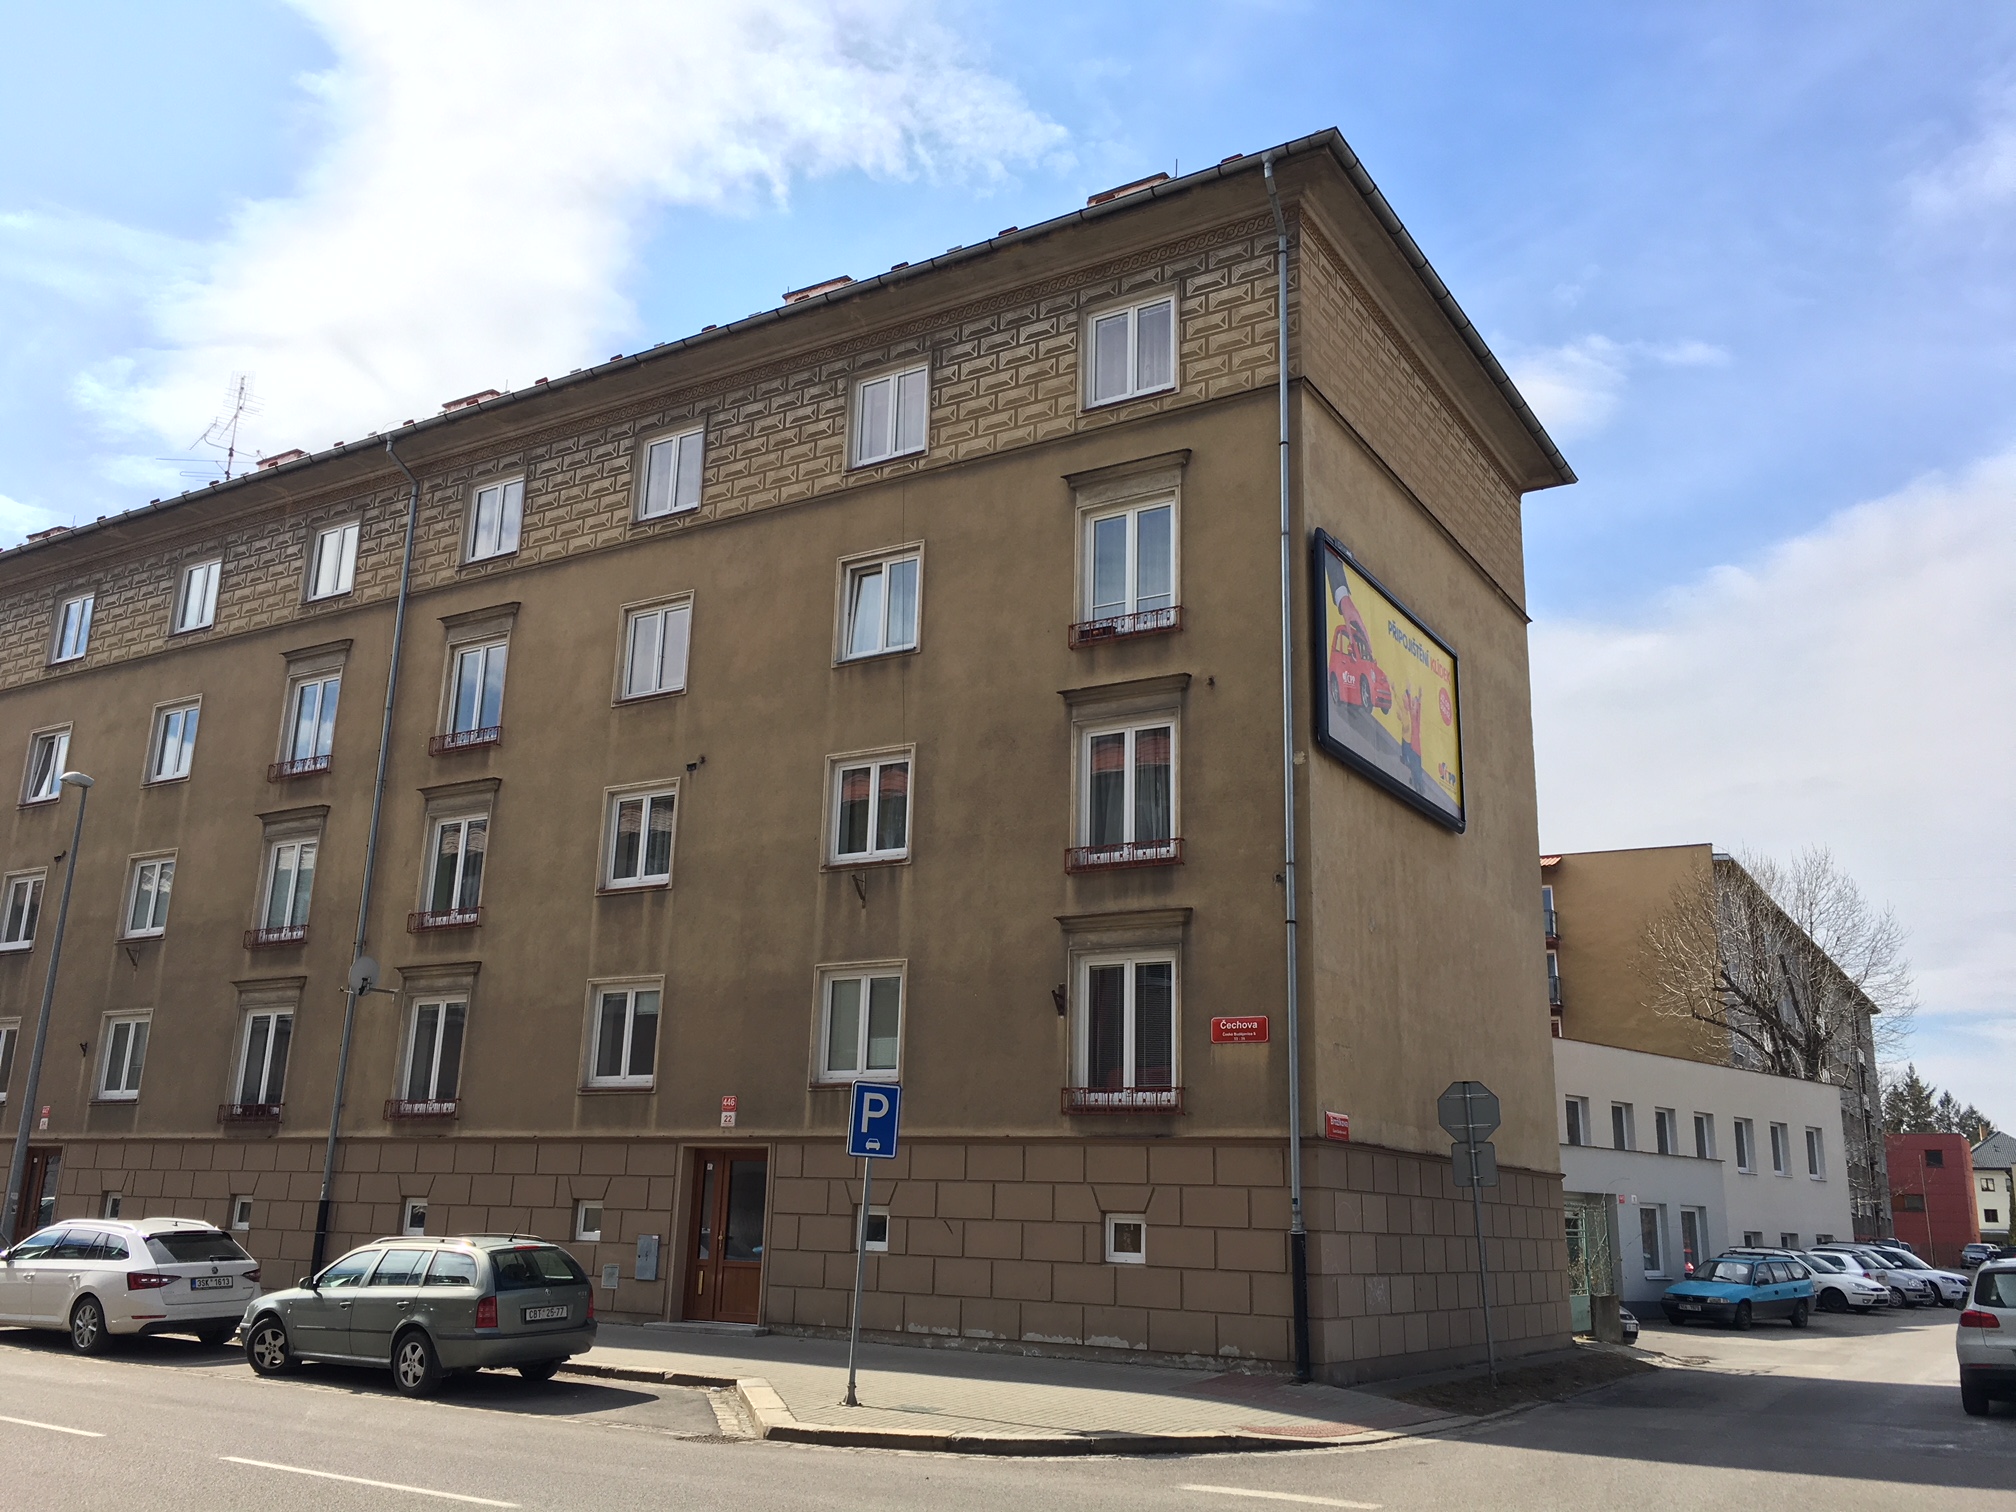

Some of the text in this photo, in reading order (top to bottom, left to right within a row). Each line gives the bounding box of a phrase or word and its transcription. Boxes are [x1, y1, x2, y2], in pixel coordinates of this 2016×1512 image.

[1220, 1019, 1258, 1029] Čechova
[723, 1098, 735, 1106] 446
[861, 1092, 889, 1133] P
[197, 1279, 209, 1287] 3SK
[529, 1307, 564, 1319] CBT 25-77
